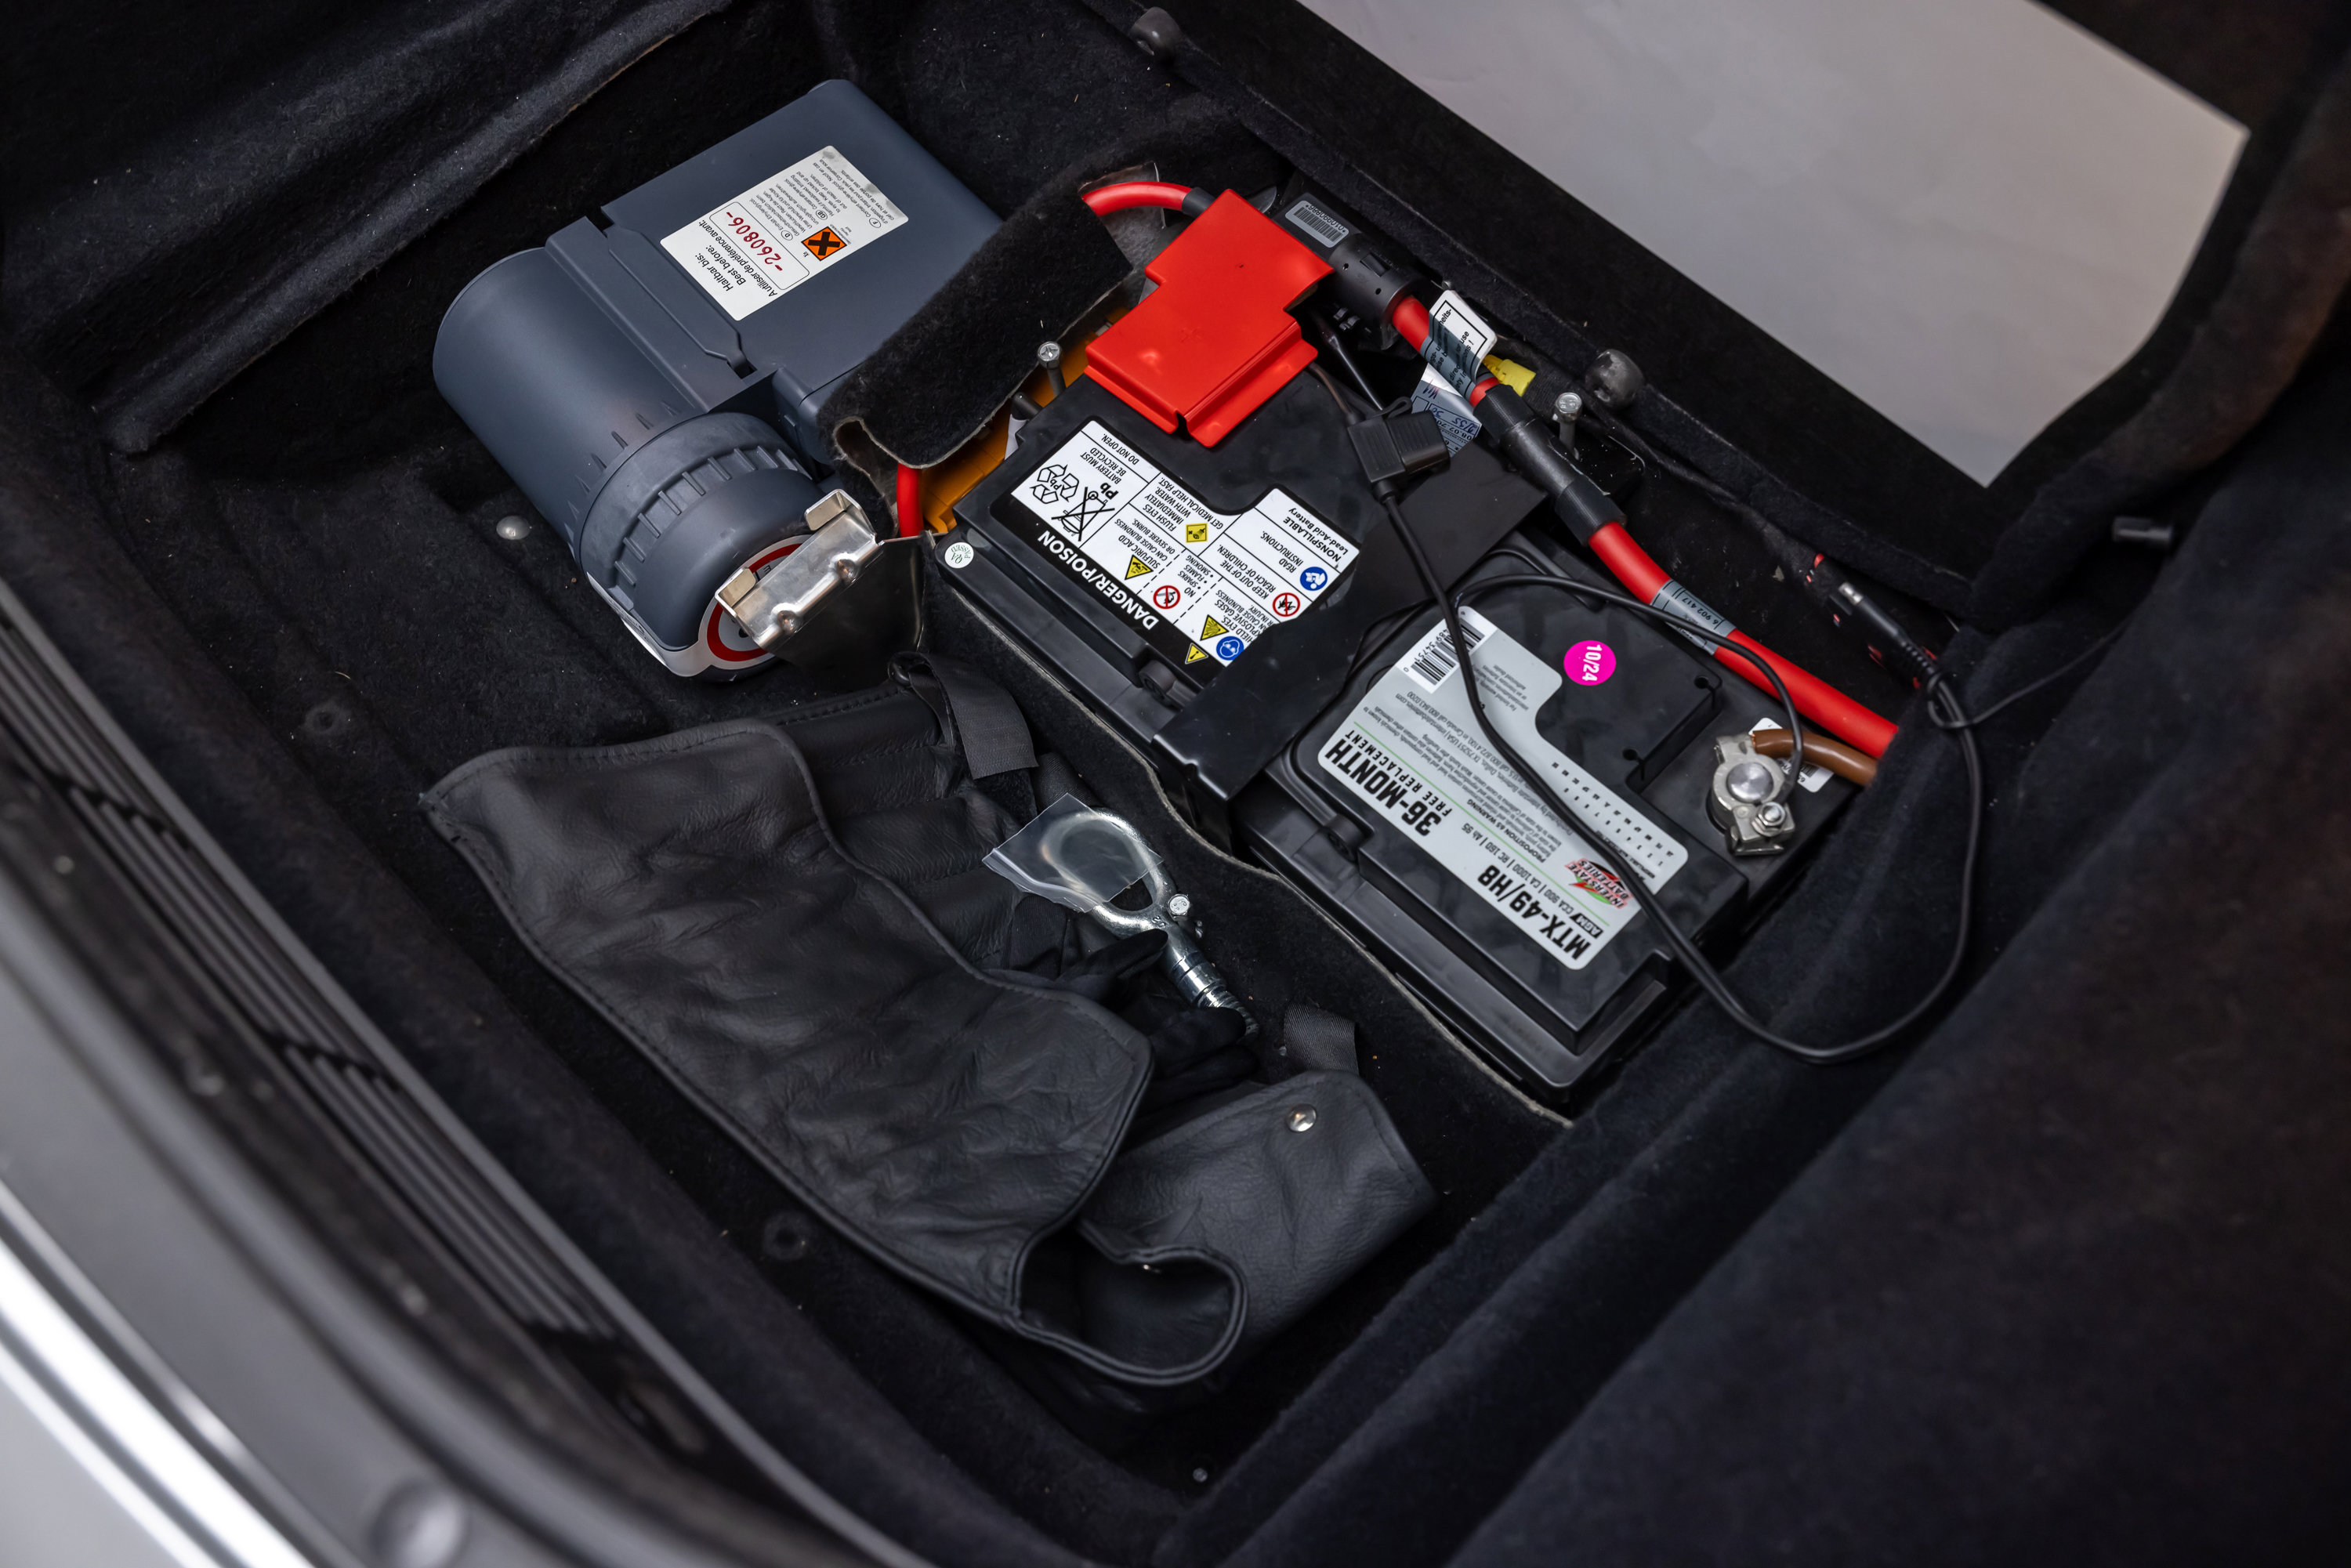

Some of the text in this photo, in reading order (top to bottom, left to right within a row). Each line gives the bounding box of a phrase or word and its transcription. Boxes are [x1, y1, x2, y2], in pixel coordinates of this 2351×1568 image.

[817, 210, 828, 219] GB
[694, 252, 734, 292] Haltbar bis:
[697, 219, 779, 297] A utiliser de préférence avant:
[704, 244, 747, 286] Best before:
[1459, 331, 1469, 345] use
[1089, 447, 1127, 477] BE RECYCLED
[1099, 433, 1140, 465] DO NOT OPEN.
[1079, 451, 1122, 485] BATTERY MUST
[1046, 476, 1063, 491] Pb
[1098, 481, 1119, 500] Pb
[1143, 493, 1184, 525] IMMEDIATELY
[1154, 486, 1192, 518] WITH WATER.
[1157, 476, 1224, 531] GET MEDICAL HELP FAST.
[1142, 503, 1177, 532] FLUSH EYES
[1288, 506, 1349, 556] Lead-Acid Battery
[1114, 518, 1168, 562] CAN CAUSE BLINDNESS
[1131, 517, 1176, 555] OR SEVERE BURNS.
[1259, 530, 1304, 567] INSTRUCTIONS.
[1282, 516, 1342, 563] NONSPILLABLE
[951, 544, 971, 559] PASSED
[951, 553, 963, 563] QA
[1117, 534, 1161, 569] SULFURIC ACID
[1184, 554, 1212, 576] SMOKING
[1277, 557, 1297, 574] READ
[1037, 530, 1159, 631] DANGER/POISON
[1176, 570, 1199, 588] SPARKS
[1183, 563, 1205, 582] FLAMES
[1216, 544, 1277, 593] REACH OF CHILDREN.
[1219, 559, 1270, 600] KEEP OUT OF THE
[1183, 586, 1197, 598] NO
[1682, 597, 1697, 608] 417
[1213, 598, 1235, 617] GASES
[1215, 588, 1261, 626] CAUSE BLINDNESS
[1247, 604, 1270, 623] INJURY.
[1697, 608, 1712, 621] 902
[1219, 614, 1238, 631] EYES.
[1231, 613, 1262, 638] XPLOSIVE
[1234, 627, 1255, 643] HIELD
[1414, 641, 1436, 664] 34751
[1581, 644, 1603, 681] 10/24
[1394, 692, 1447, 735] interstatebatteries.com
[1406, 690, 1440, 718] 800.843.0200
[1436, 713, 1448, 723] call
[1444, 719, 1465, 737] Canada
[1446, 733, 1460, 746] USA
[1461, 732, 1470, 741] in
[1455, 741, 1476, 759] 75251
[1466, 736, 1503, 767] 800.872.4100,
[1471, 753, 1481, 763] TX
[1344, 729, 1453, 817] FREE REPLACEMENT
[1480, 758, 1498, 776] Dallas,
[1325, 738, 1441, 836] 36-MONTH
[1466, 798, 1546, 864] PROPOSITION 65 WARNING
[1460, 821, 1574, 915] CCA 900 CA 1000 RC 160 Ah 95
[1576, 856, 1631, 903] BATTERIES
[1566, 860, 1626, 911] INTERSTATE
[1476, 864, 1592, 960] MTX-49/H8
[1575, 914, 1601, 936] AGM
